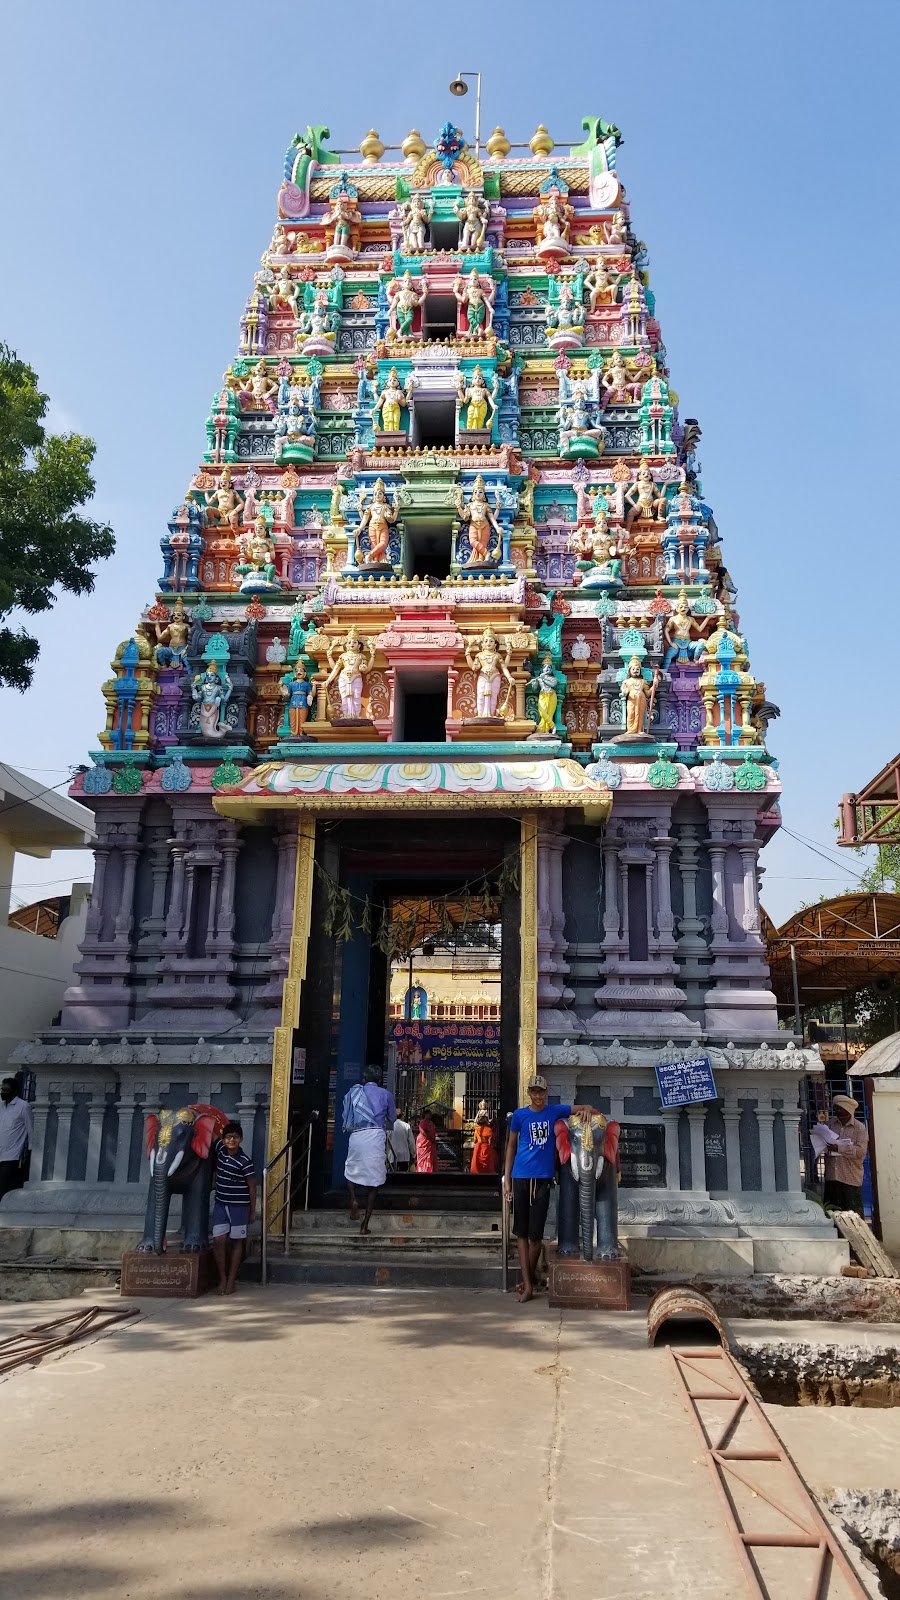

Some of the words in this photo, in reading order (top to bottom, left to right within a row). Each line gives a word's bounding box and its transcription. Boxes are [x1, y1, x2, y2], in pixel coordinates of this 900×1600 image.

[394, 1023, 404, 1036] శ్రీ
[531, 1121, 548, 1130] EXP
[532, 1129, 548, 1139] EDI
[532, 1137, 548, 1146] TION
